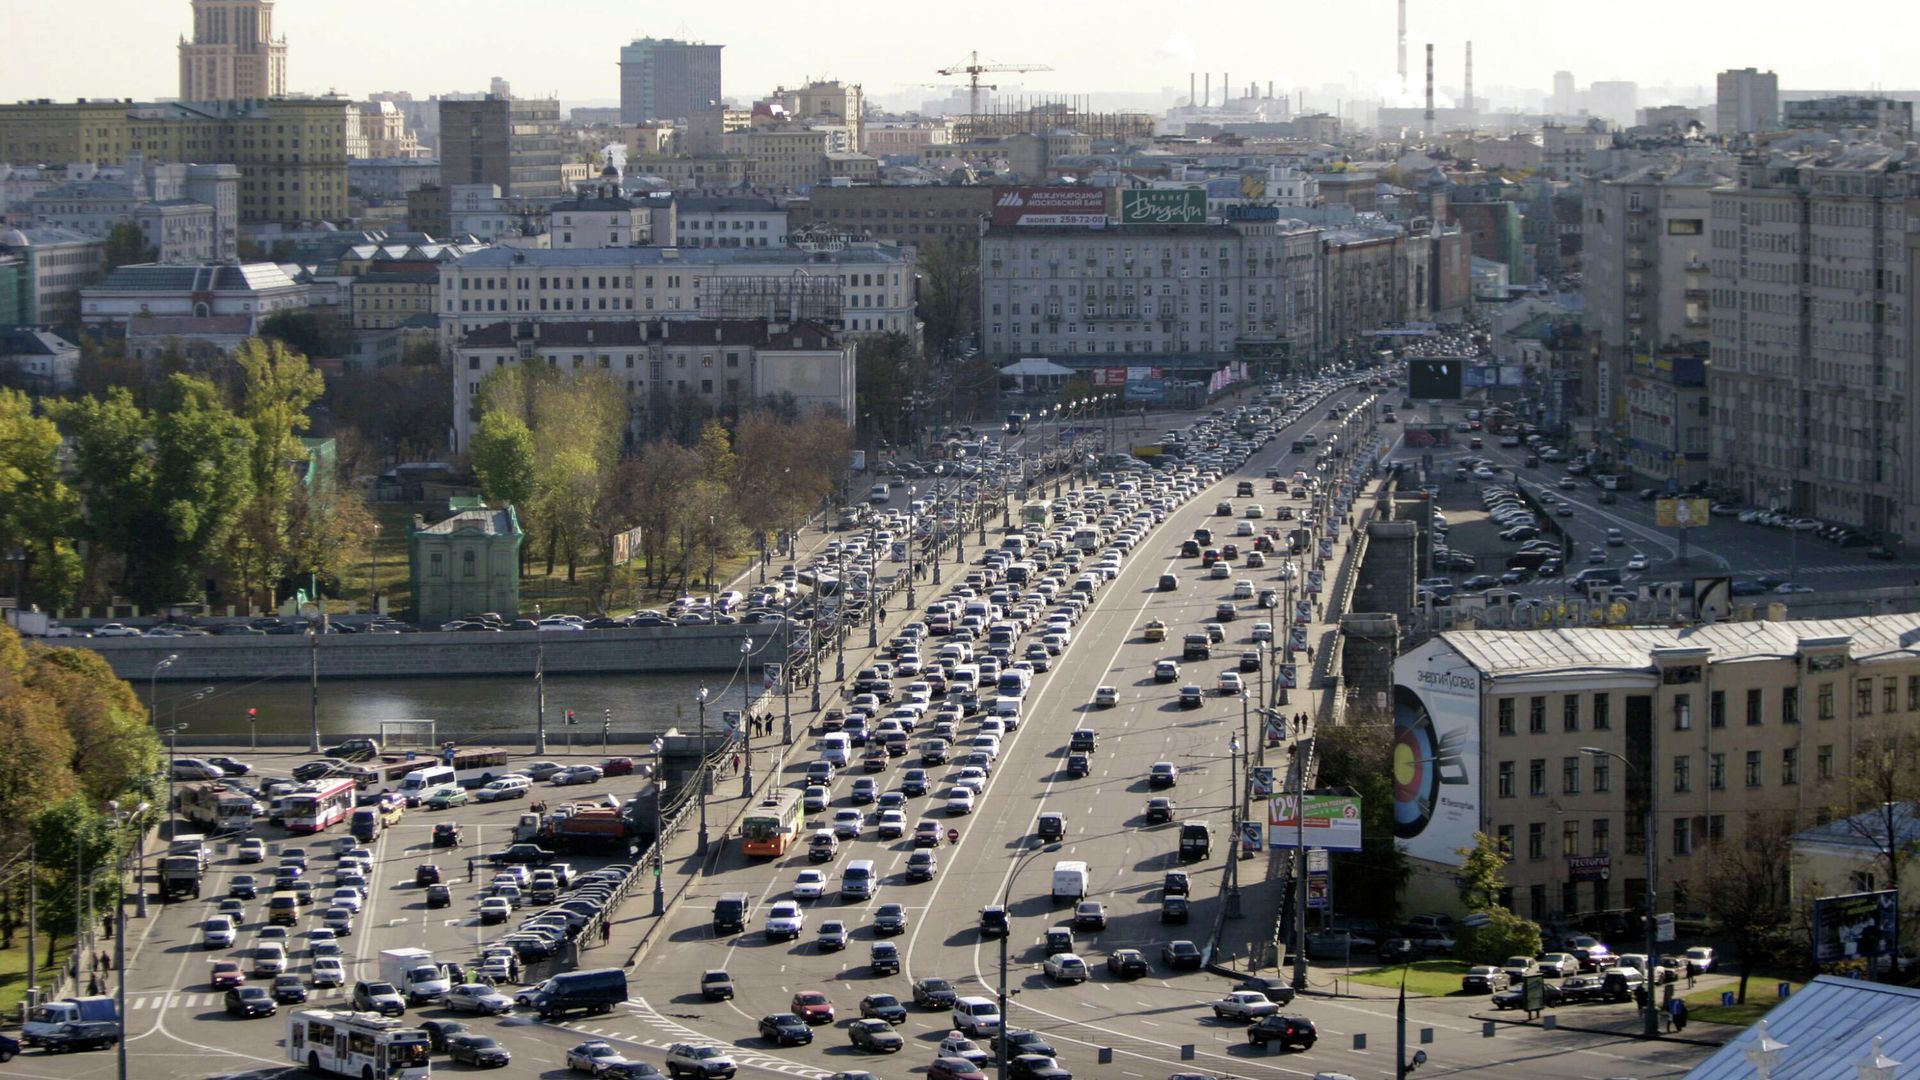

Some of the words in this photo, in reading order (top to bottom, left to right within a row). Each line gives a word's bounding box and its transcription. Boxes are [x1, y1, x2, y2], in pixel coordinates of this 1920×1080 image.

[1032, 191, 1103, 200] МЕЖДУНАРОДНЫЙ
[1027, 199, 1082, 207] МОСКОВСКИЙ
[1083, 199, 1102, 207] БАНК
[1125, 191, 1202, 222] Визави
